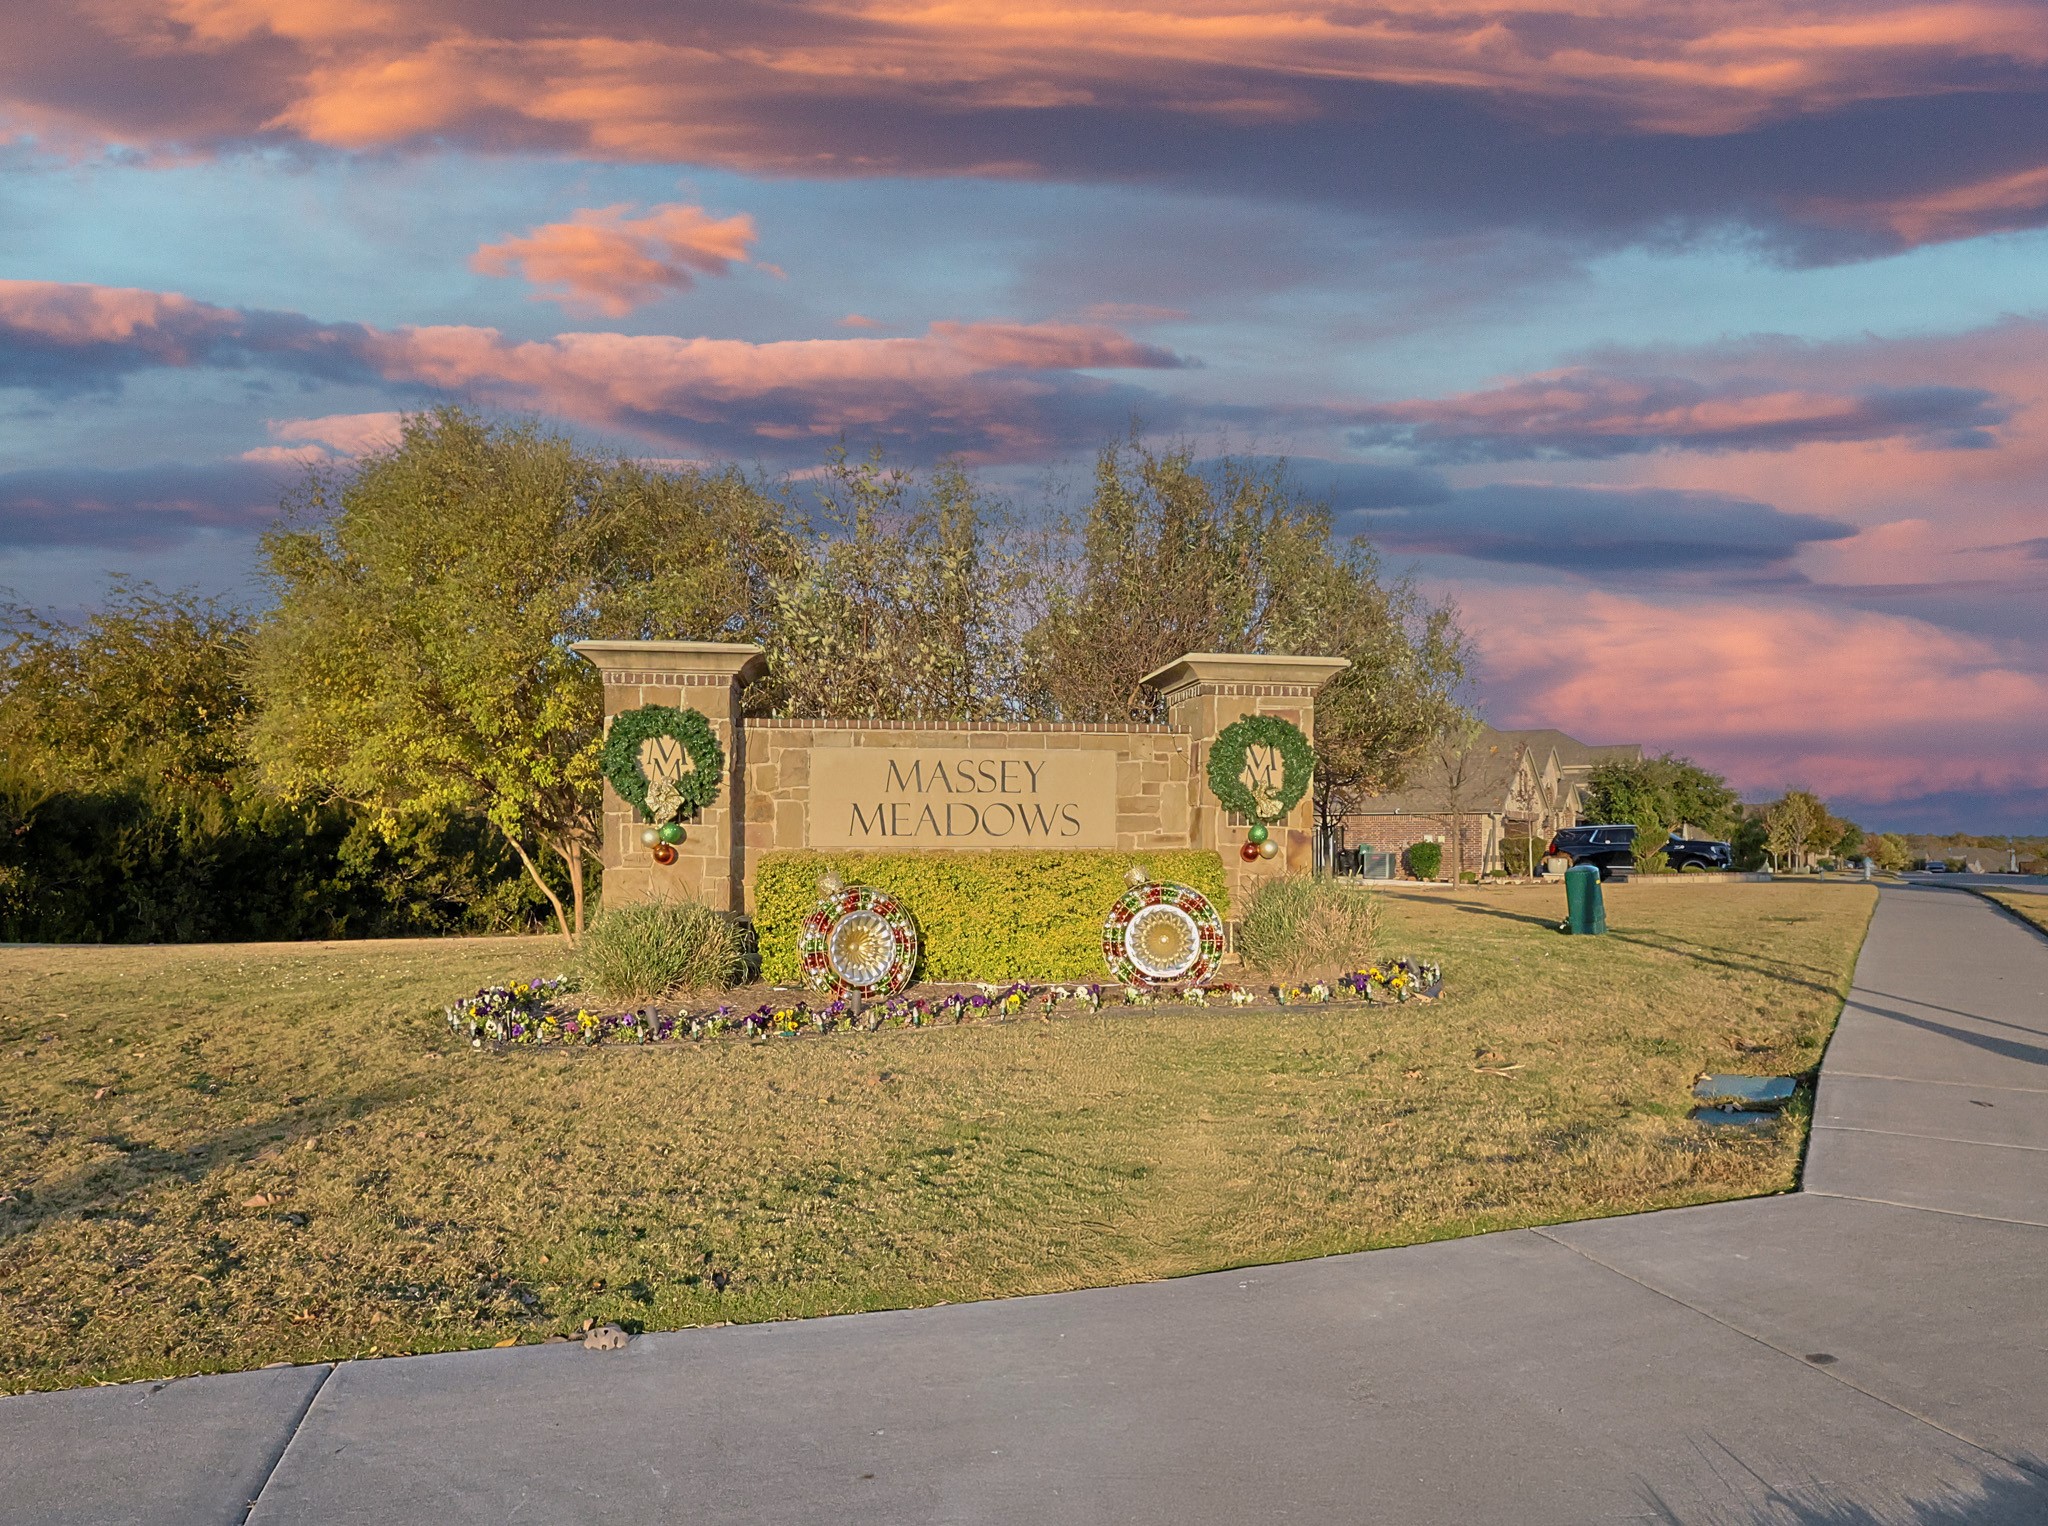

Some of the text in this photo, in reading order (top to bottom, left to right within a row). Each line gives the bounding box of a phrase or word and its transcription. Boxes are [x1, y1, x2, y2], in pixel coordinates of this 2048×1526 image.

[647, 737, 688, 765] M
[885, 759, 1046, 793] MASSEY
[849, 803, 1081, 837] MEADOWS
